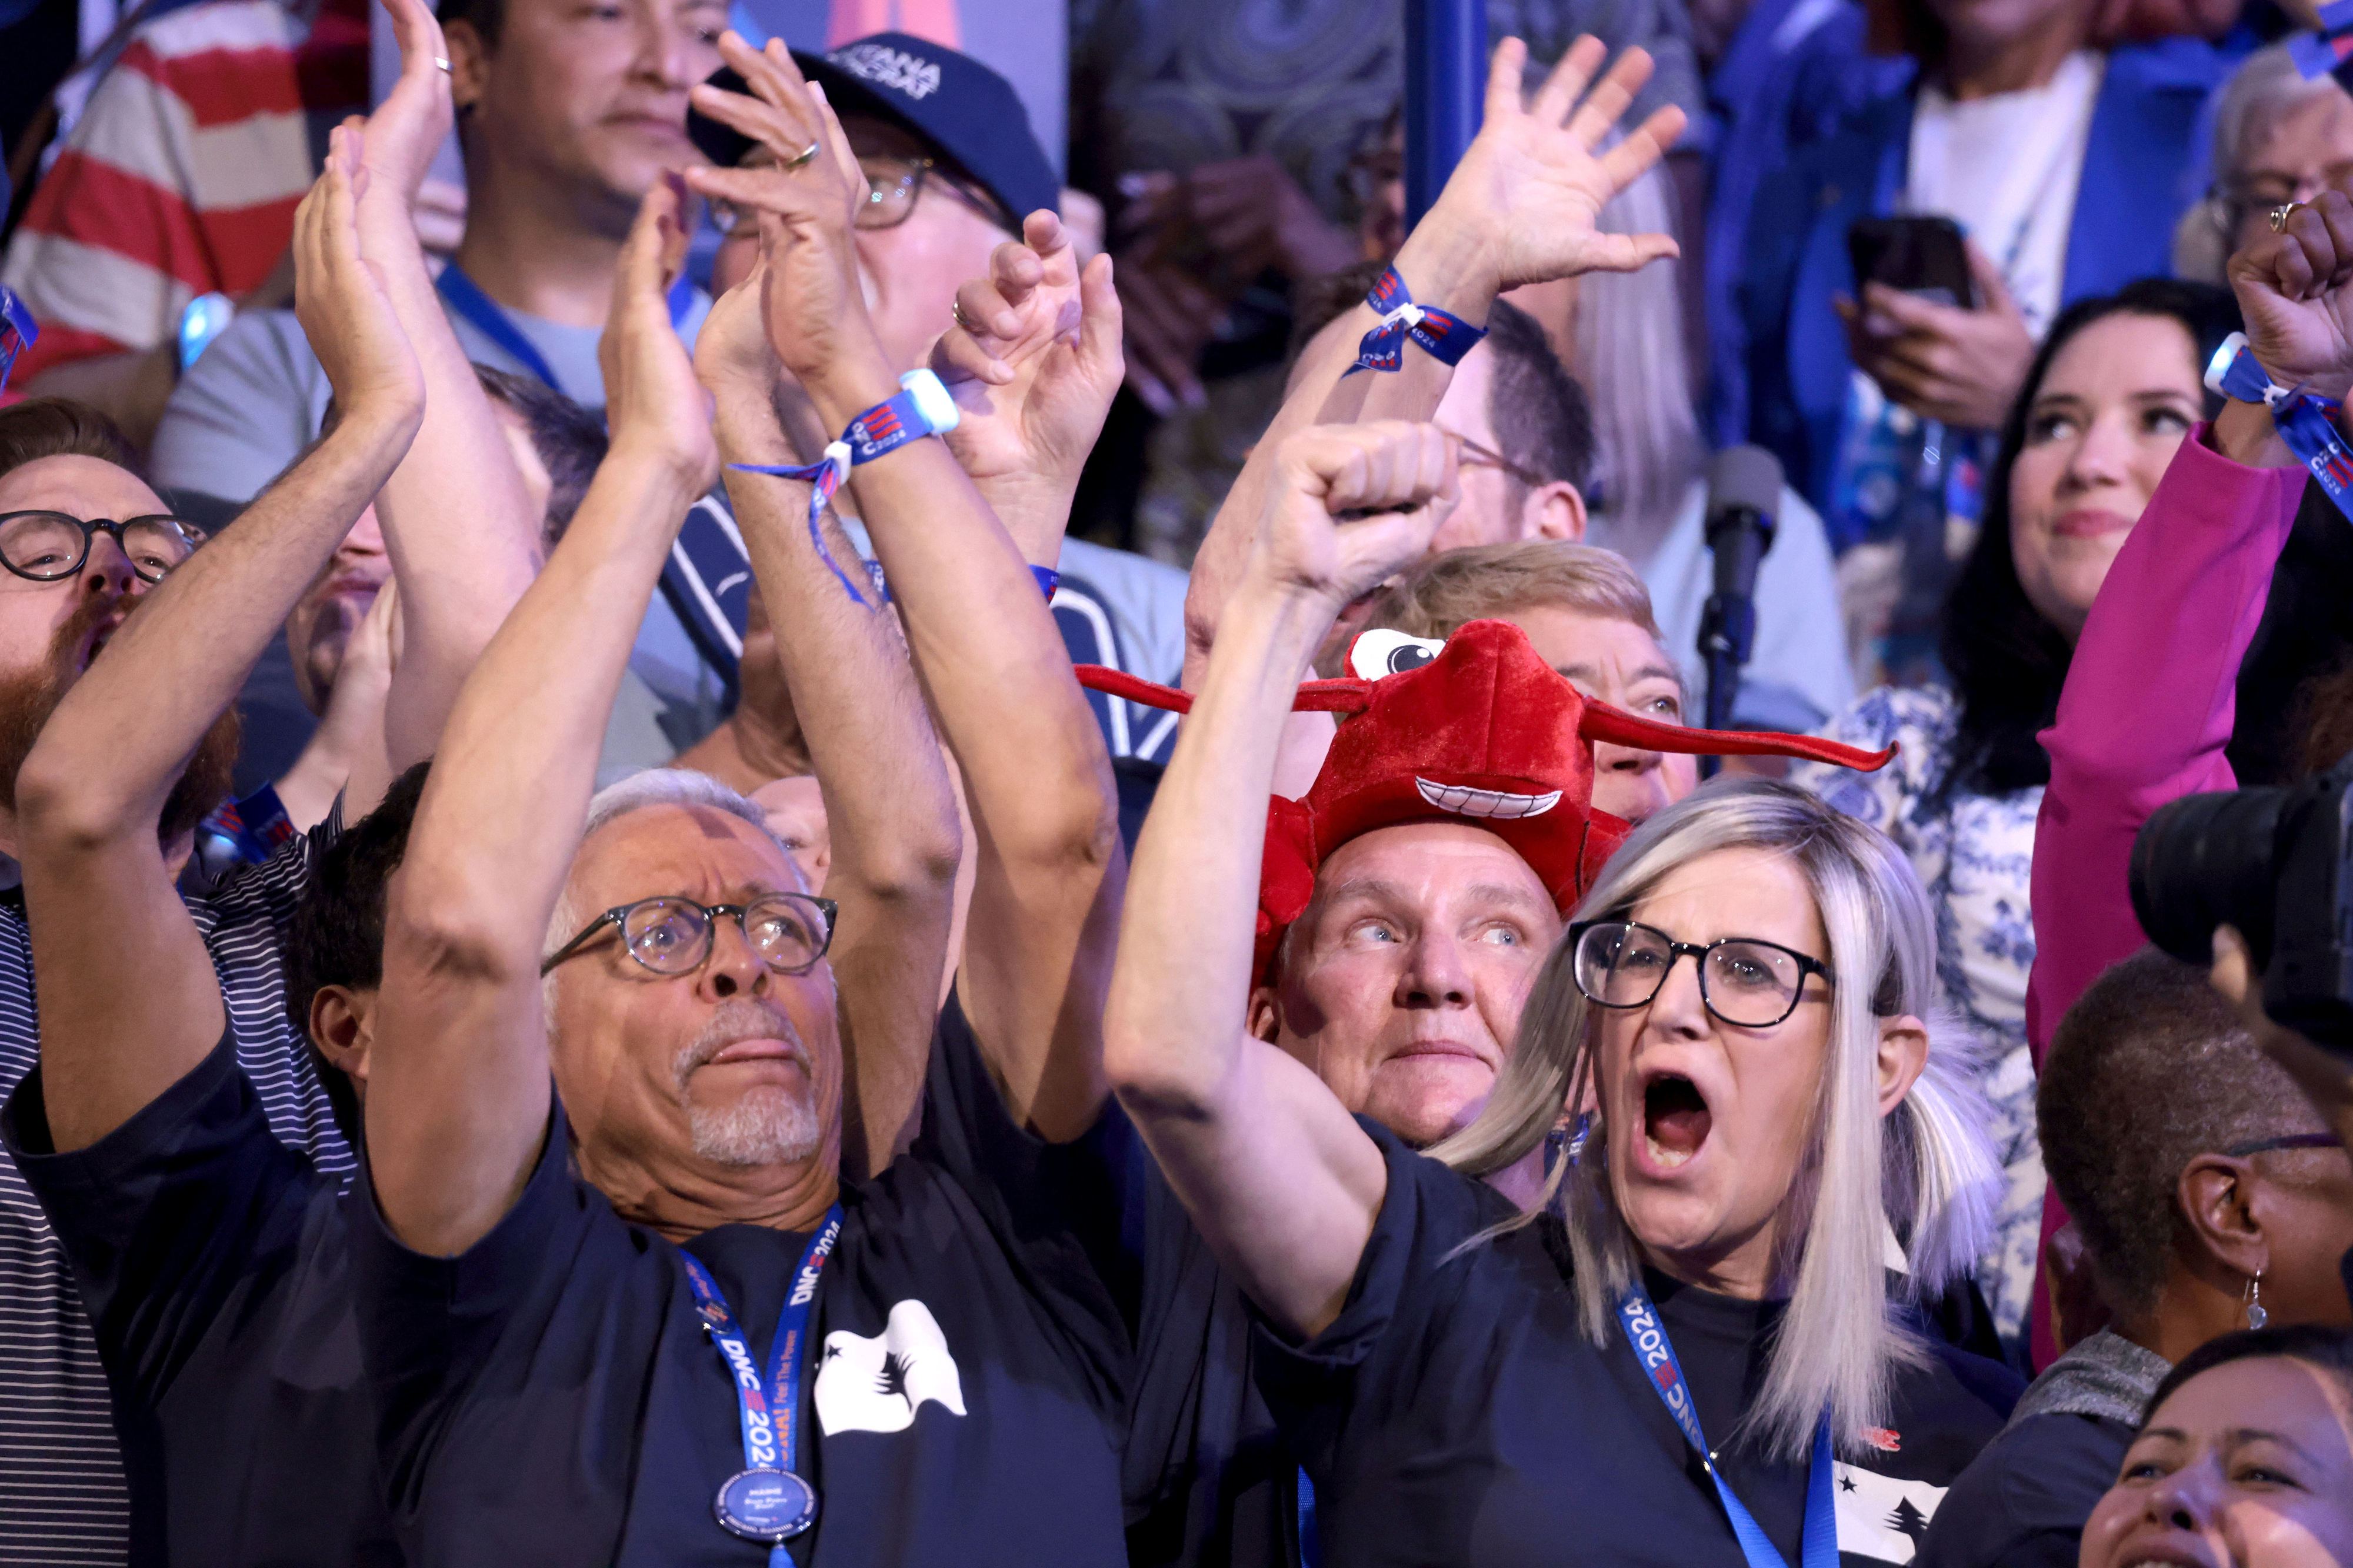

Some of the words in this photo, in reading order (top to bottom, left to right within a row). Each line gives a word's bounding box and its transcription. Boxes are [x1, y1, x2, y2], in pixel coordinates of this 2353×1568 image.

[789, 1265, 819, 1306] DNC
[1624, 1296, 1669, 1369] 2024
[720, 1339, 761, 1392] DNC
